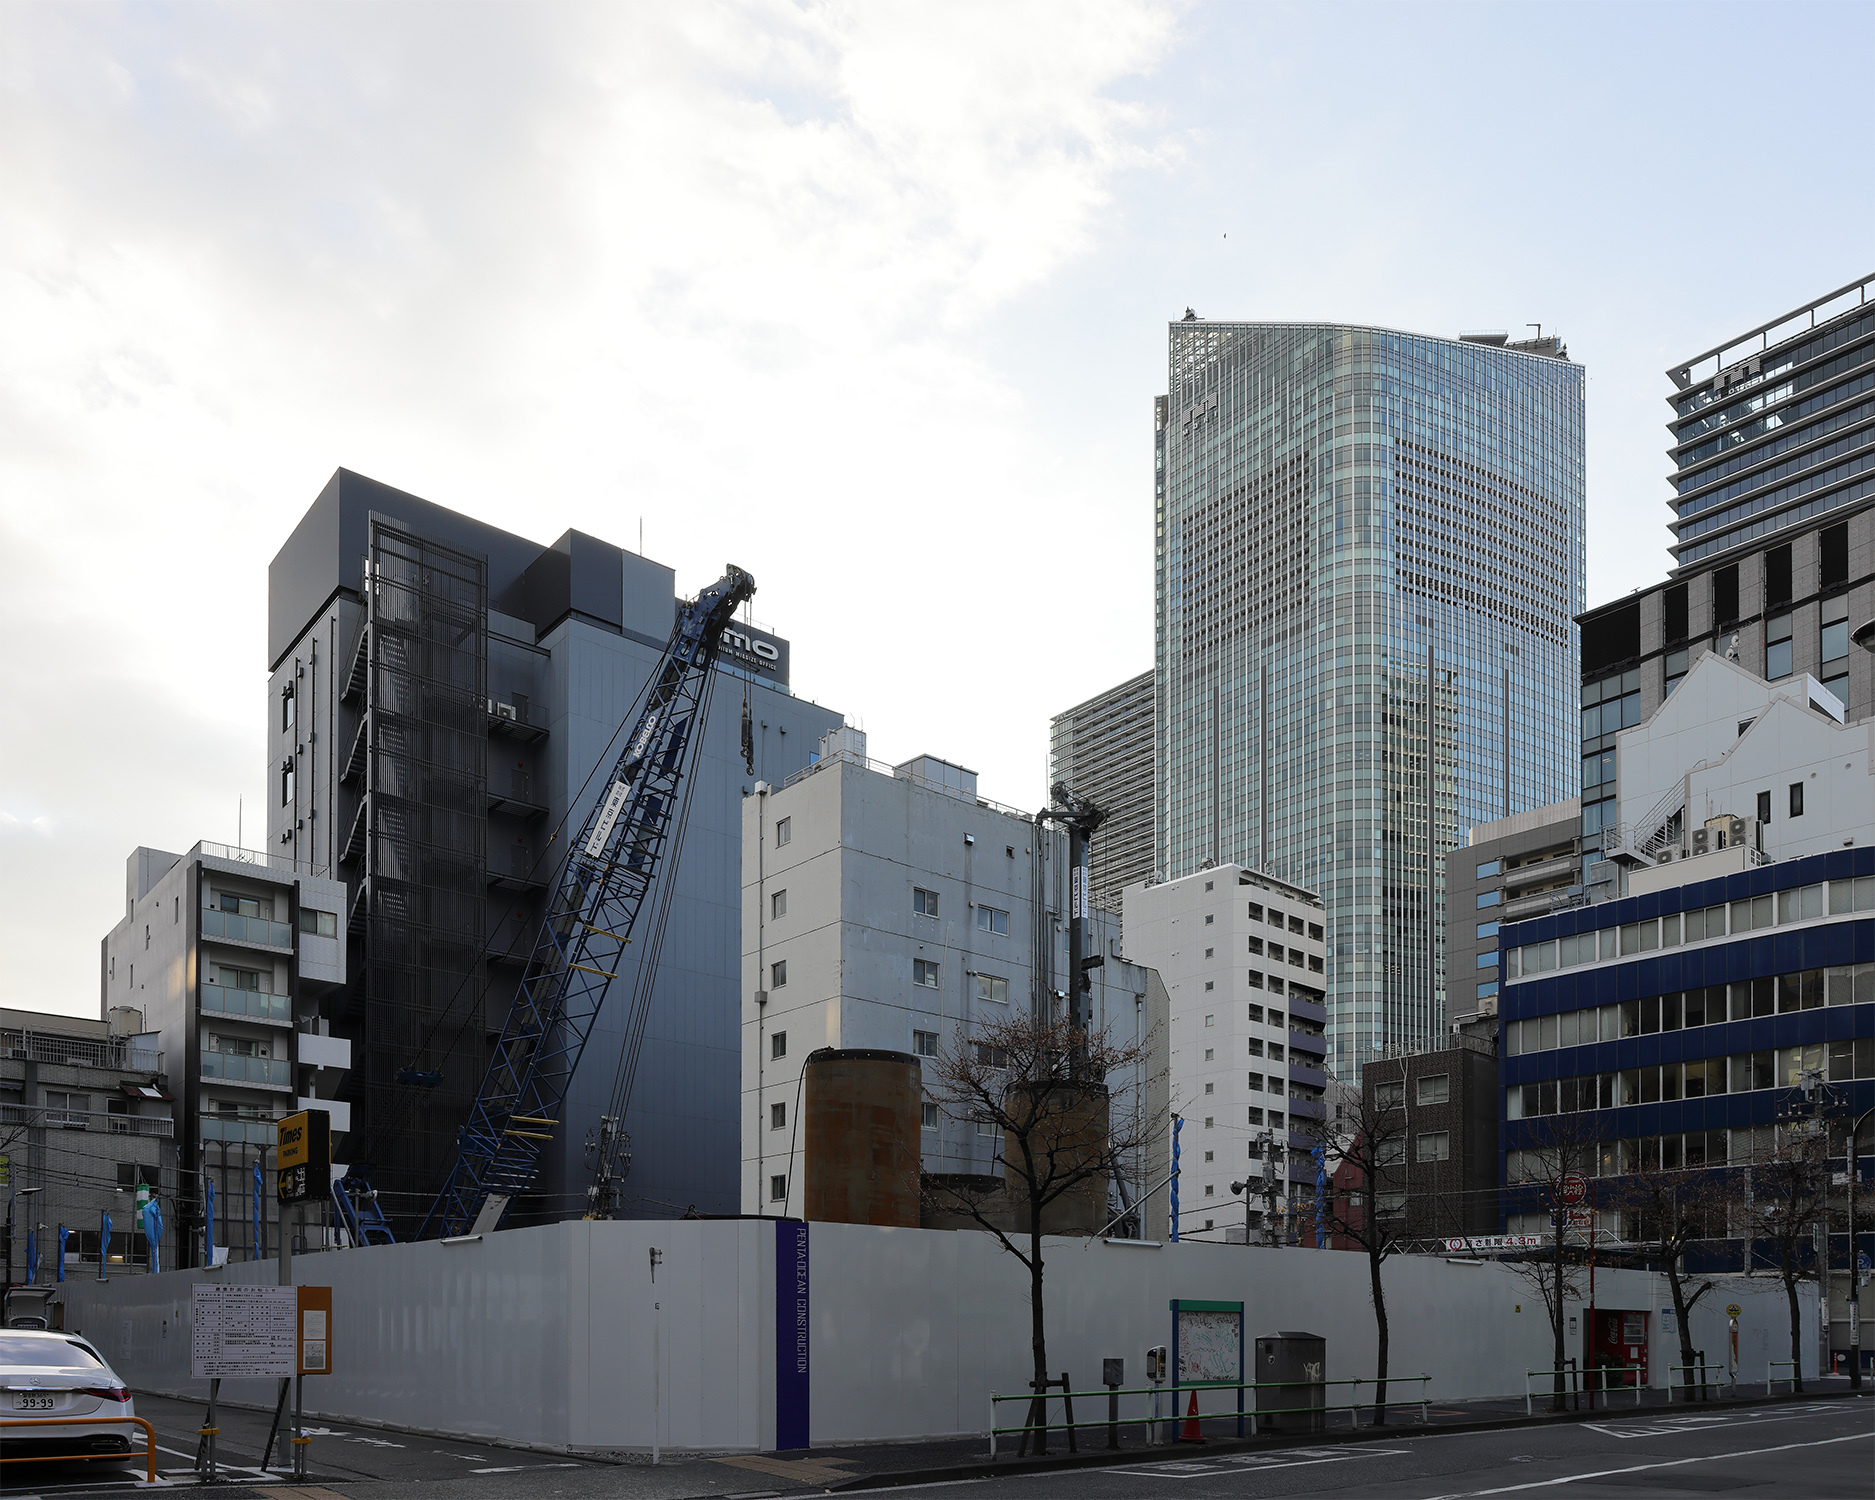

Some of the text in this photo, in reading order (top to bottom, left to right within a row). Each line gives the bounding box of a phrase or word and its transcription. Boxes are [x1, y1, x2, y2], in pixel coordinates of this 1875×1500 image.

[719, 627, 779, 660] mo
[759, 660, 777, 671] OFFICE
[633, 716, 656, 758] KOBELCO
[279, 1126, 302, 1147] Times
[282, 1146, 298, 1158] PARKING
[1506, 1236, 1537, 1246] 4.3m
[796, 1228, 807, 1373] PENTA-OCEAN CONSTRUCTION
[22, 1399, 53, 1408] 99-99
